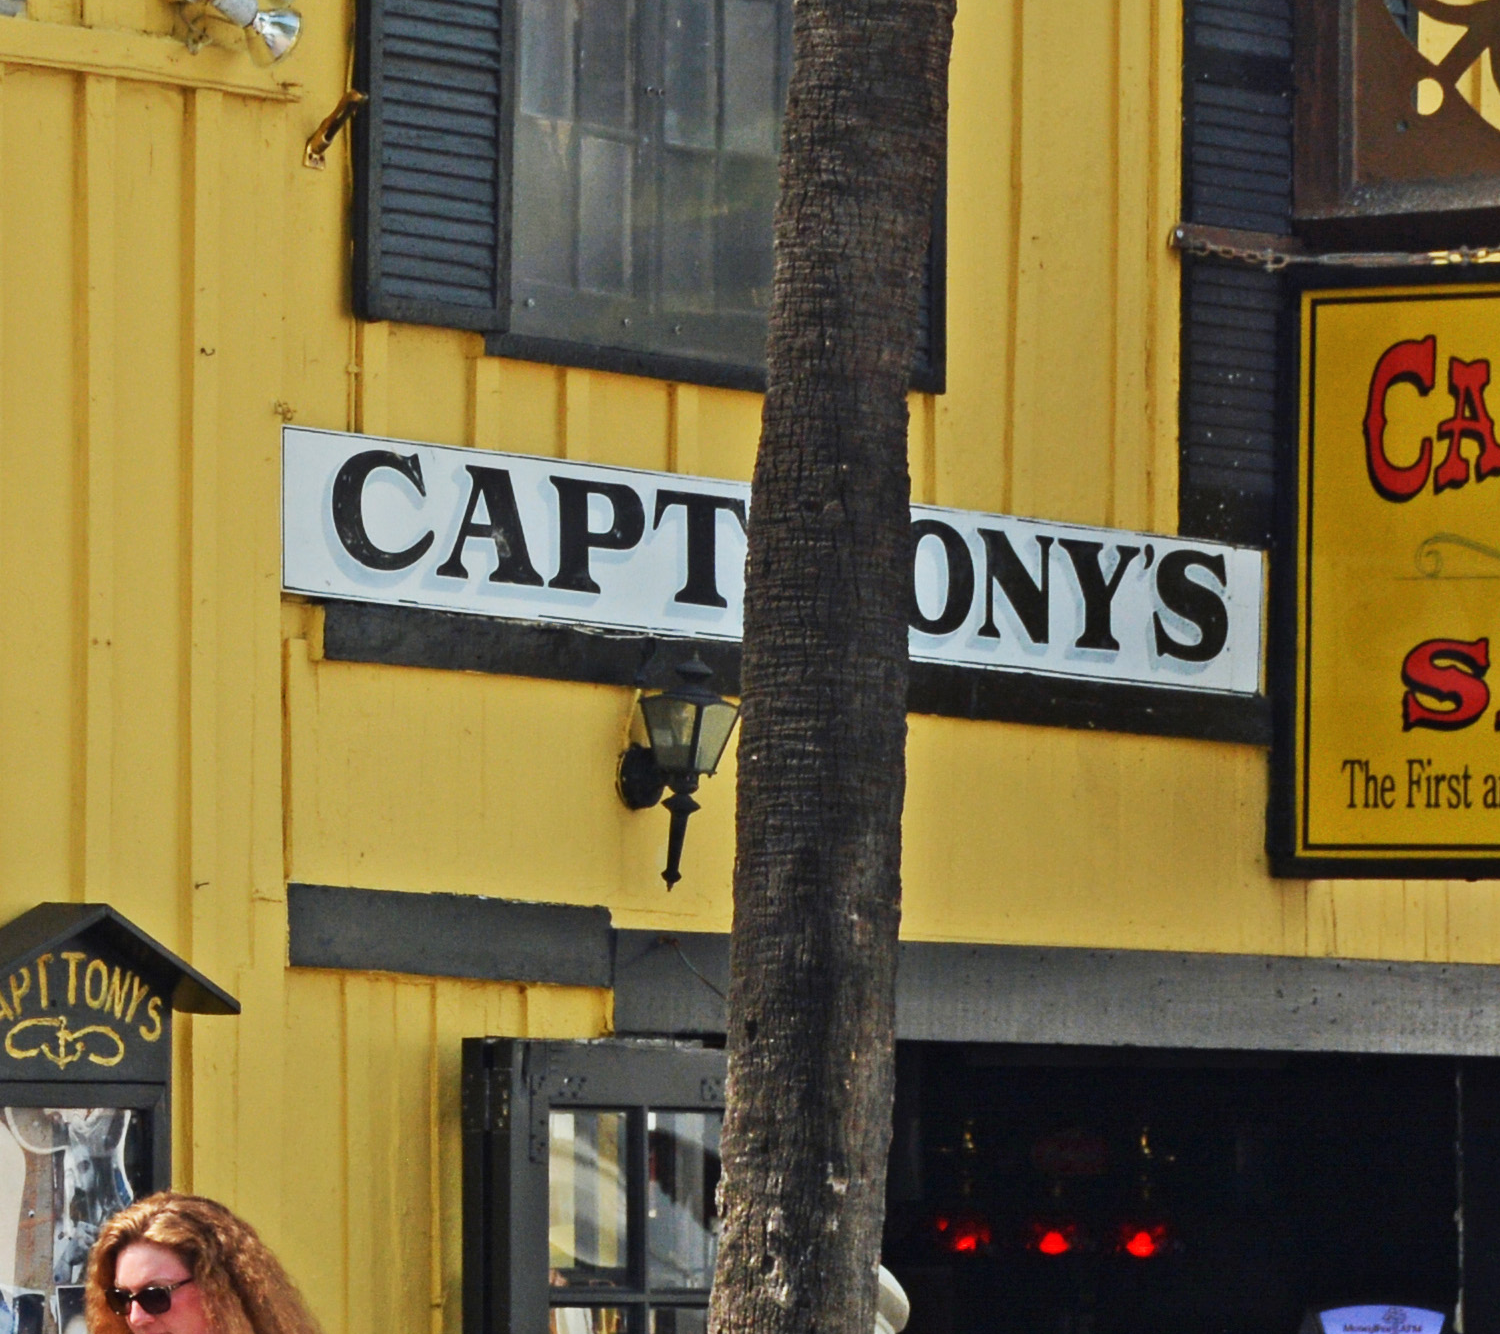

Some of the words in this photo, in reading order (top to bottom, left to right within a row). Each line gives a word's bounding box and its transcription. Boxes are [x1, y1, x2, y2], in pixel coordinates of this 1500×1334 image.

[330, 448, 748, 610] CAPT
[907, 517, 1229, 663] ONY'S
[1341, 759, 1396, 811] The
[1405, 758, 1473, 810] First
[60, 951, 164, 1043] TONYS
